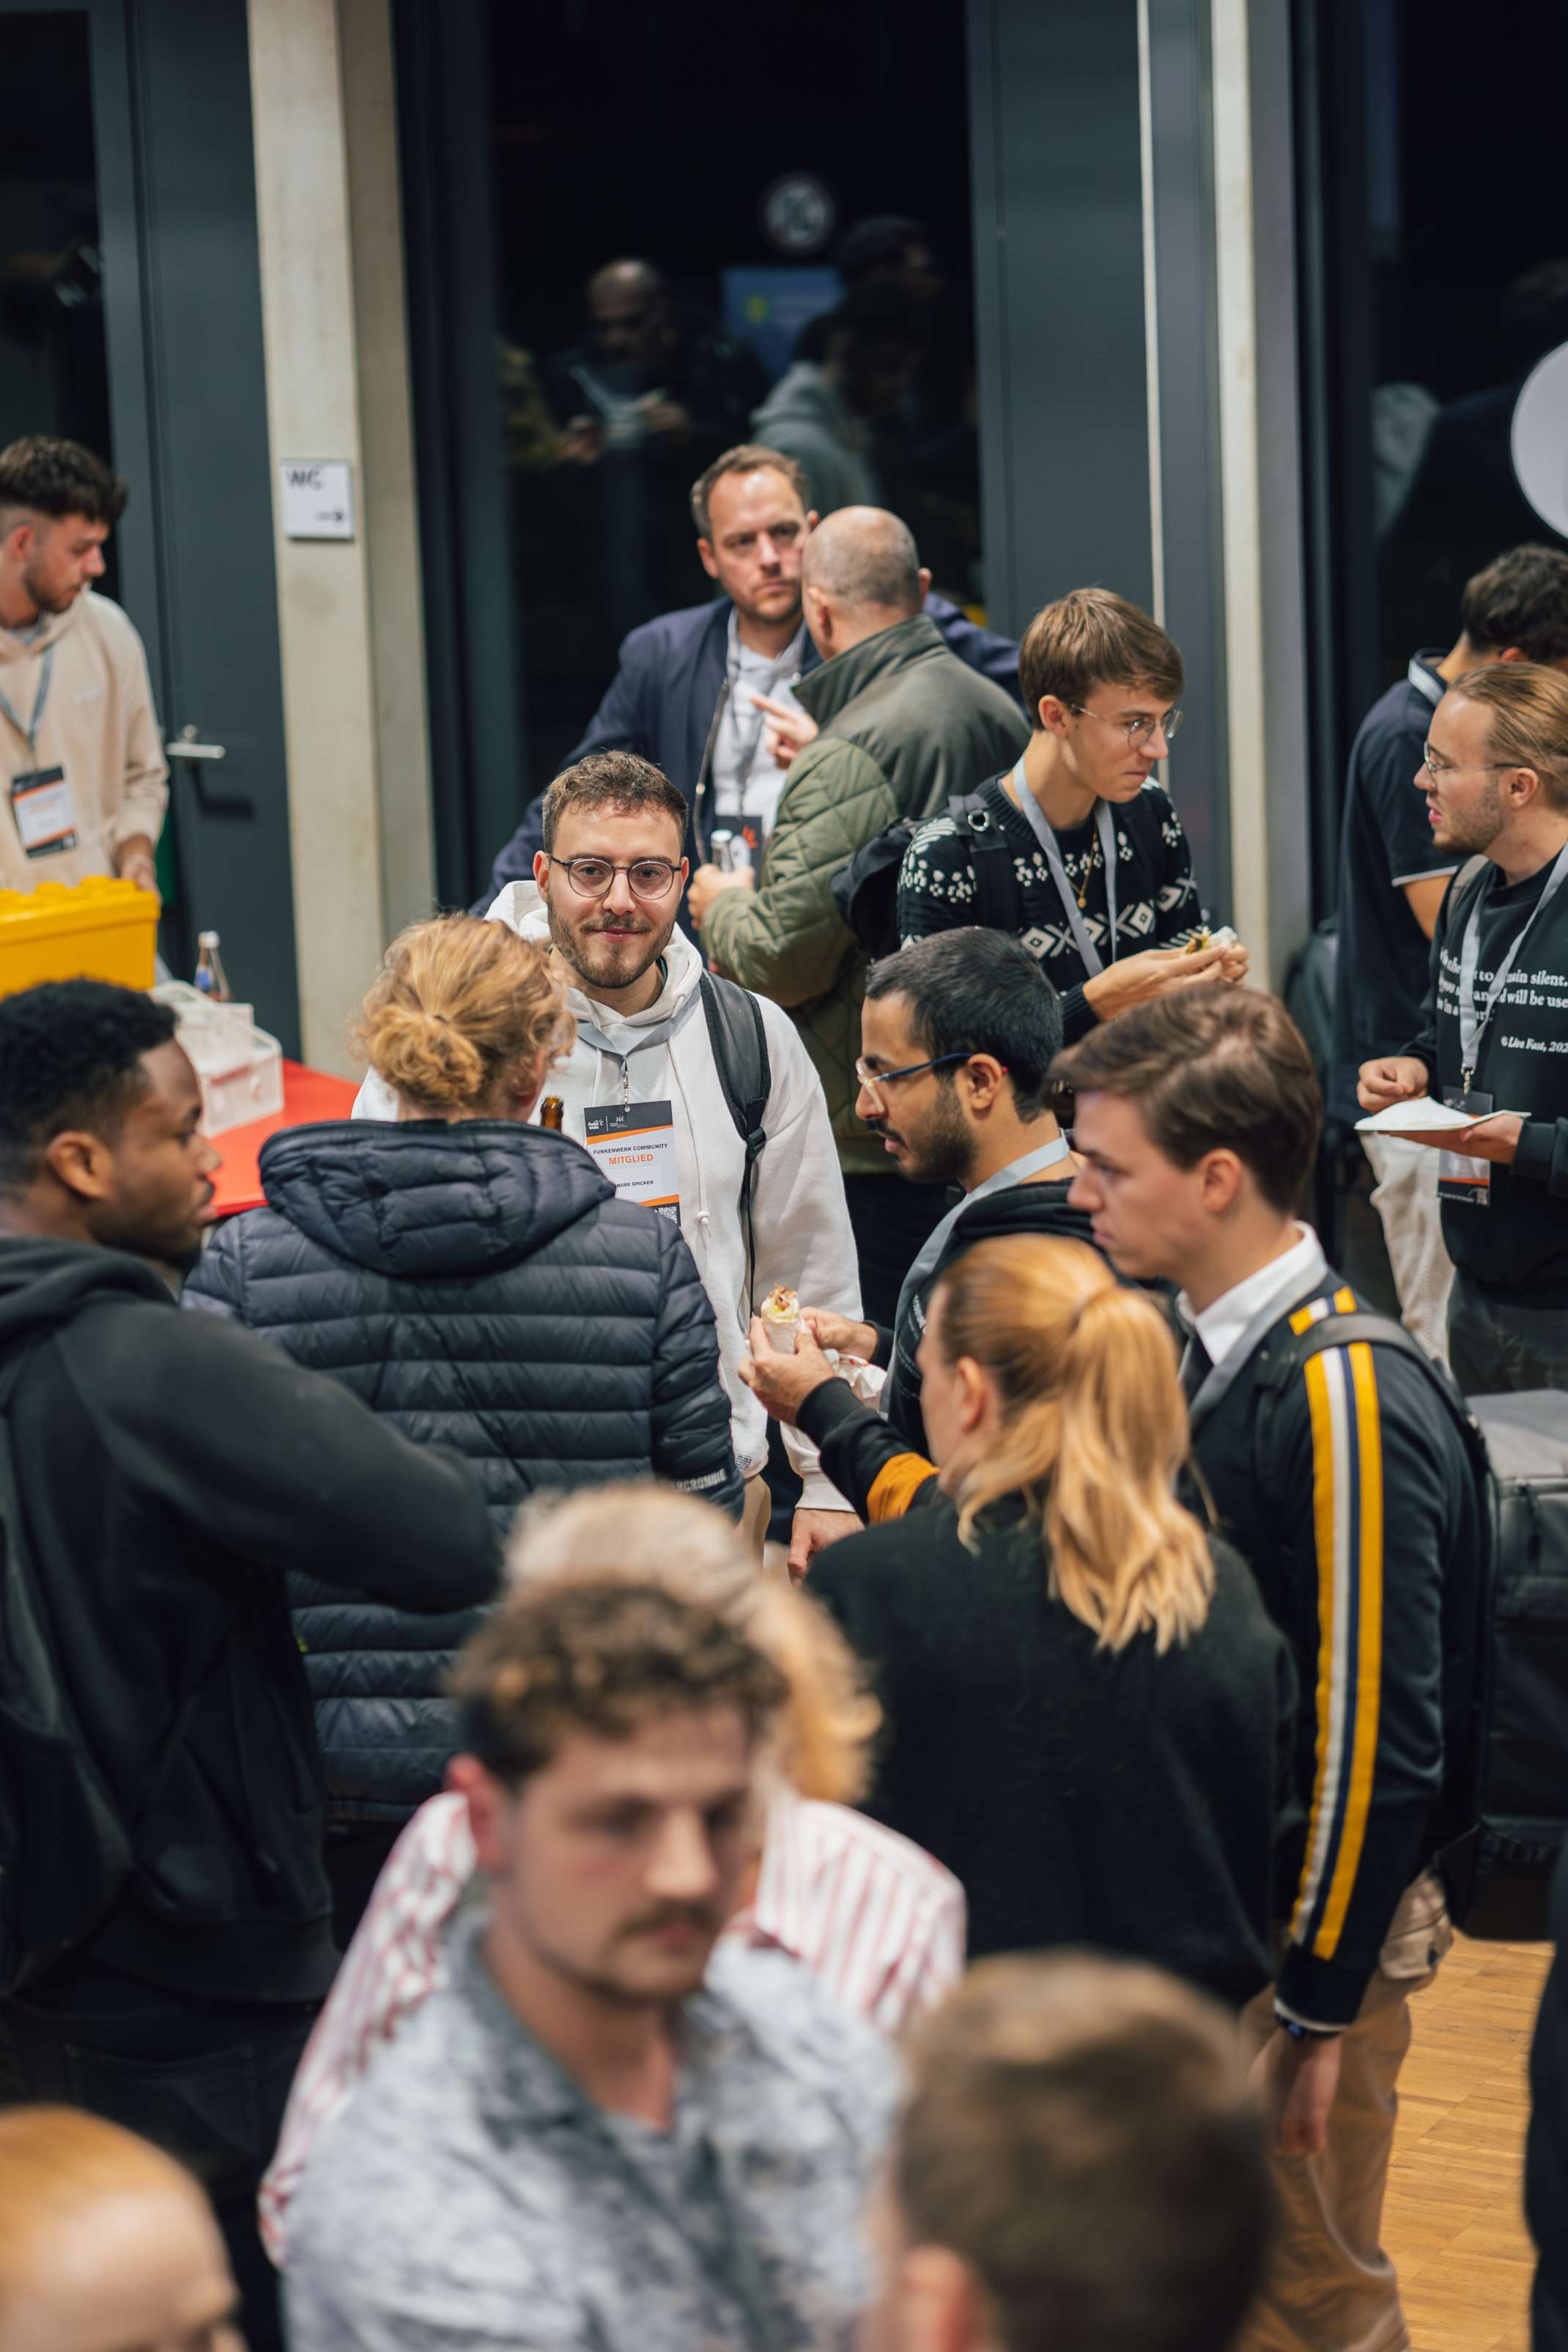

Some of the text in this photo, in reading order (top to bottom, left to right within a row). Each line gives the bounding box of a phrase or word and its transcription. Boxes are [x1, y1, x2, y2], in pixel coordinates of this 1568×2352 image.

[285, 466, 325, 489] WC
[1479, 970, 1494, 981] to
[1530, 970, 1568, 987] silent.
[1507, 989, 1528, 1005] will
[1529, 989, 1545, 1006] be
[593, 1143, 668, 1154] FUNKENWERK COMMUNITY
[609, 1154, 654, 1165] MITGLIED
